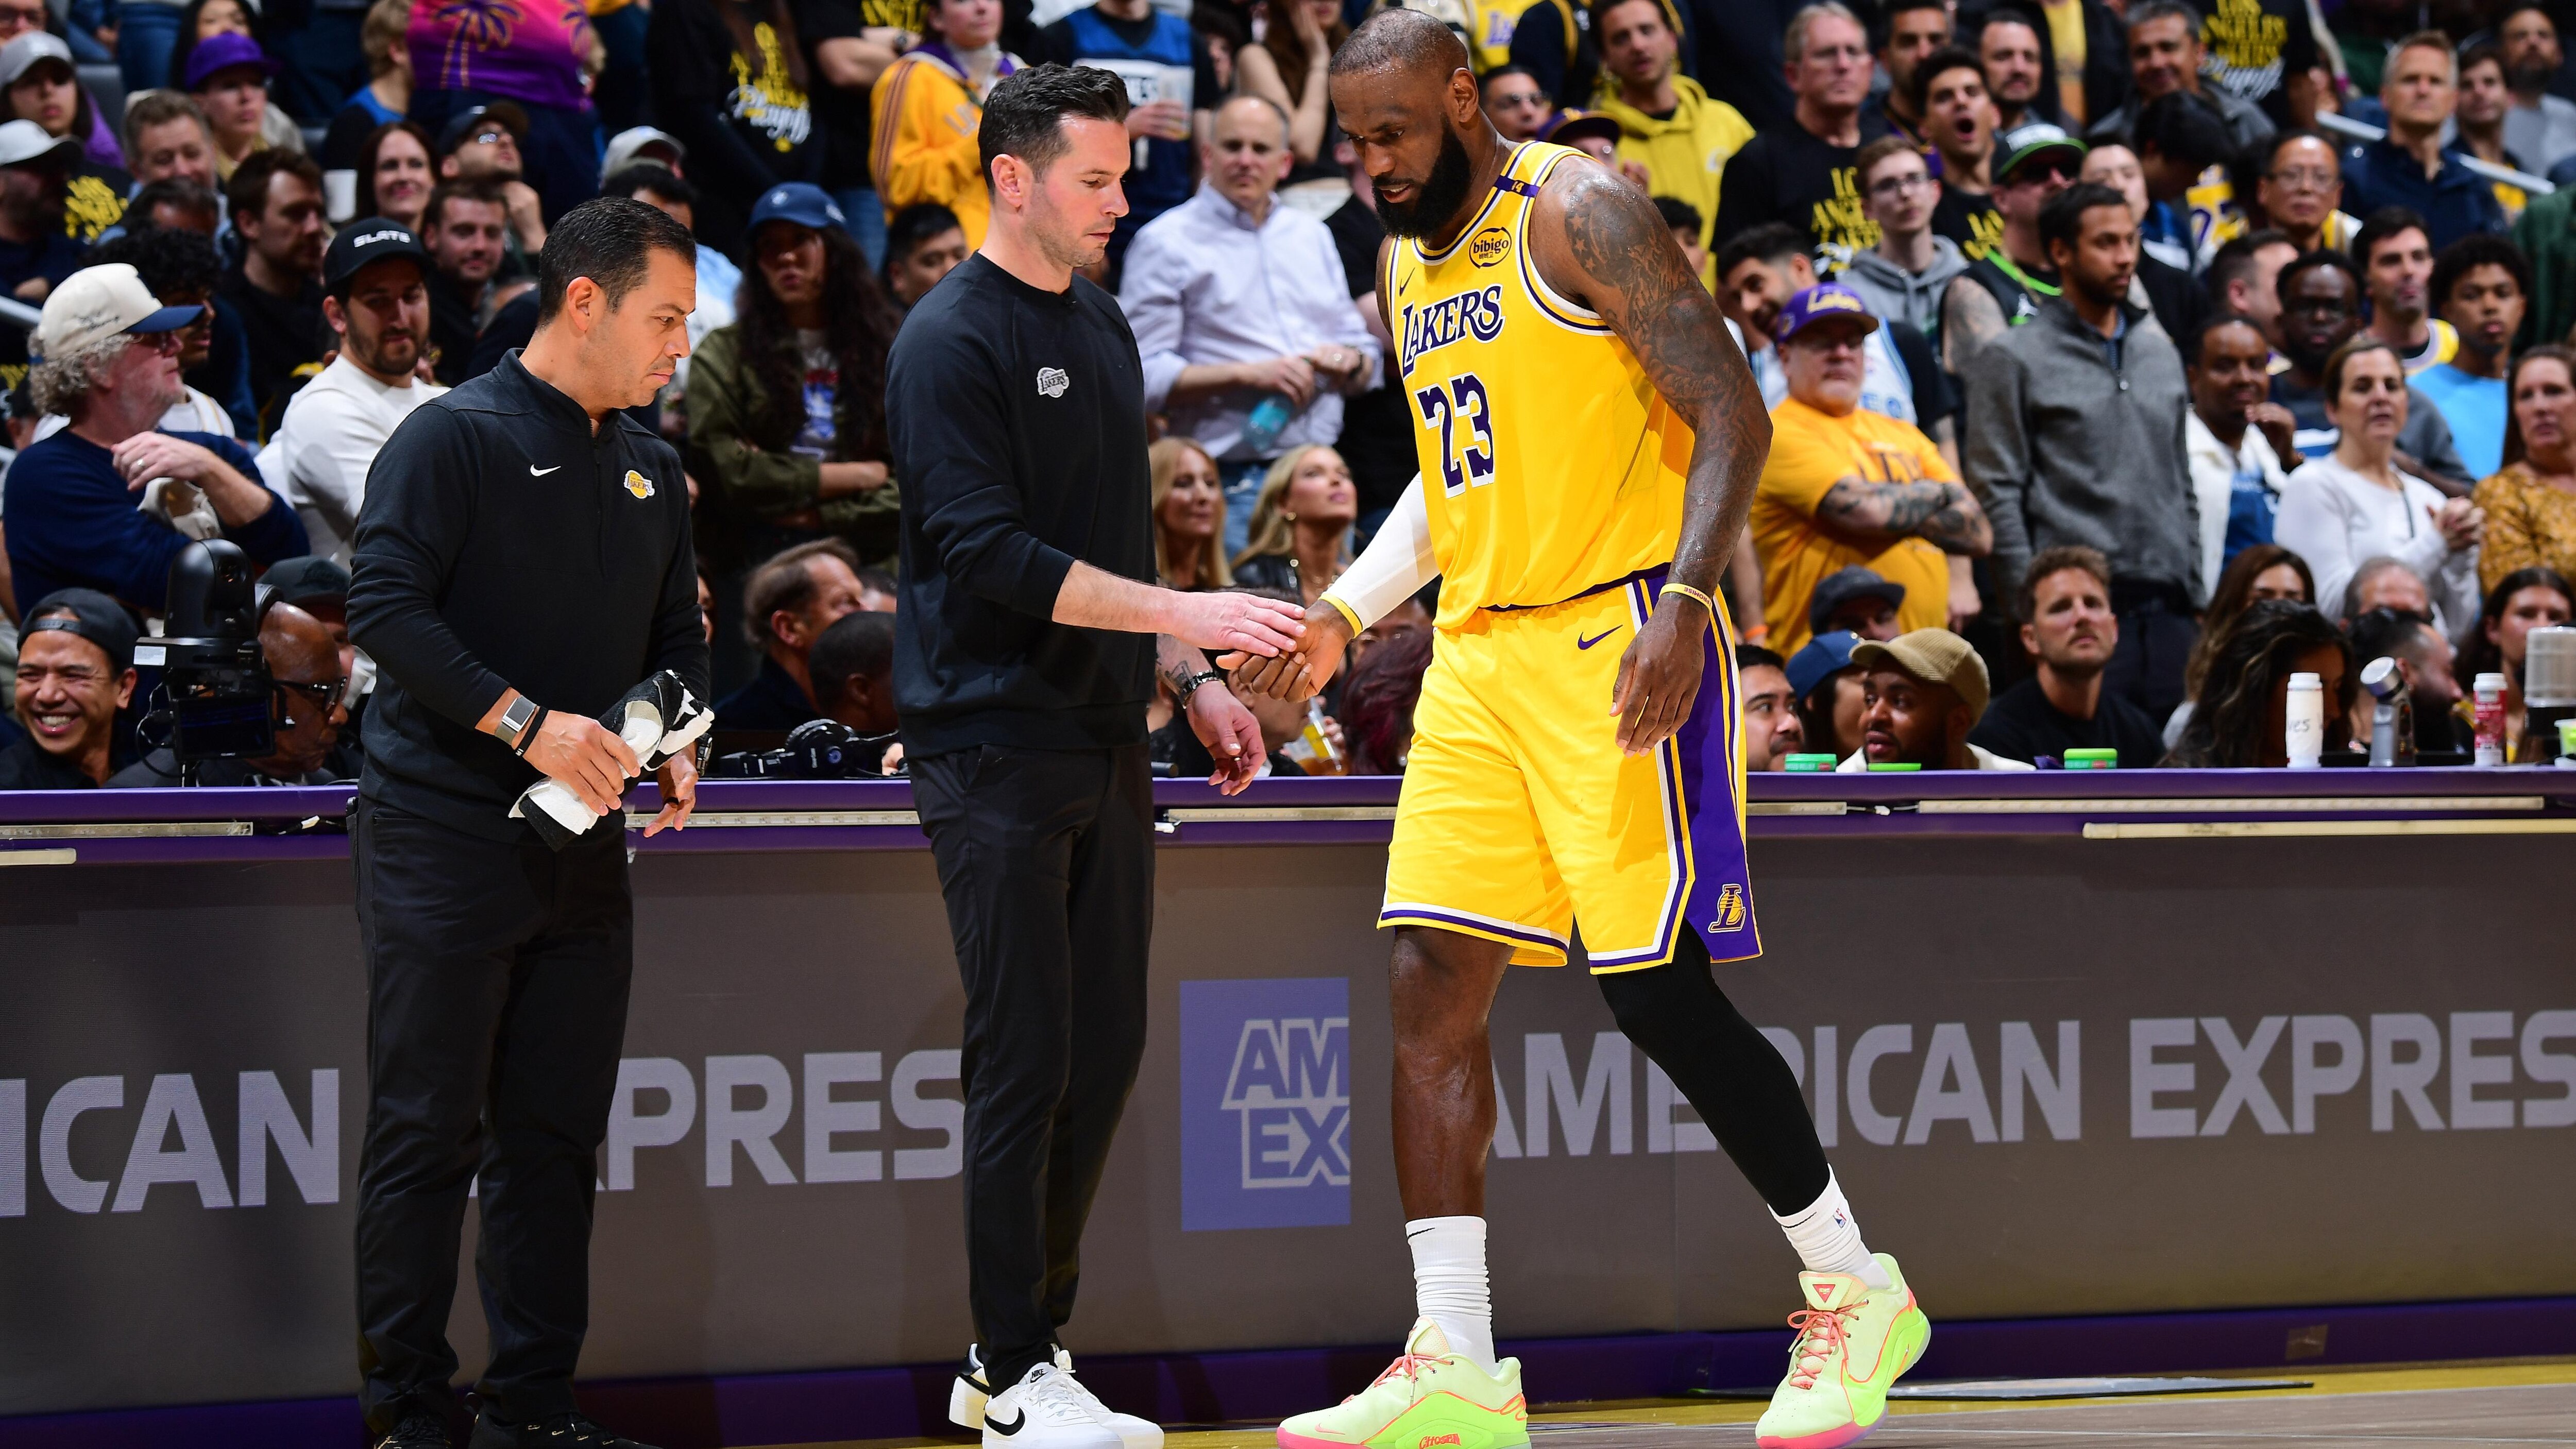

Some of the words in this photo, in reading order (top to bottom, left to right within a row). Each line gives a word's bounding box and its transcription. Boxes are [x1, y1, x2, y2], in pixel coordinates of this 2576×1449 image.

[1473, 237, 1509, 254] bibigo
[1401, 283, 1506, 380] LAKERS
[1413, 371, 1495, 499] 23
[1683, 587, 1710, 605] PROMISE
[1221, 1018, 1350, 1110] AM
[1492, 1019, 2080, 1158] MEICAN
[469, 1049, 966, 1198] PRES
[1242, 1102, 1350, 1189] EX
[1031, 1369, 1044, 1378] NIKE
[1419, 1433, 1462, 1449] CHOSEN
